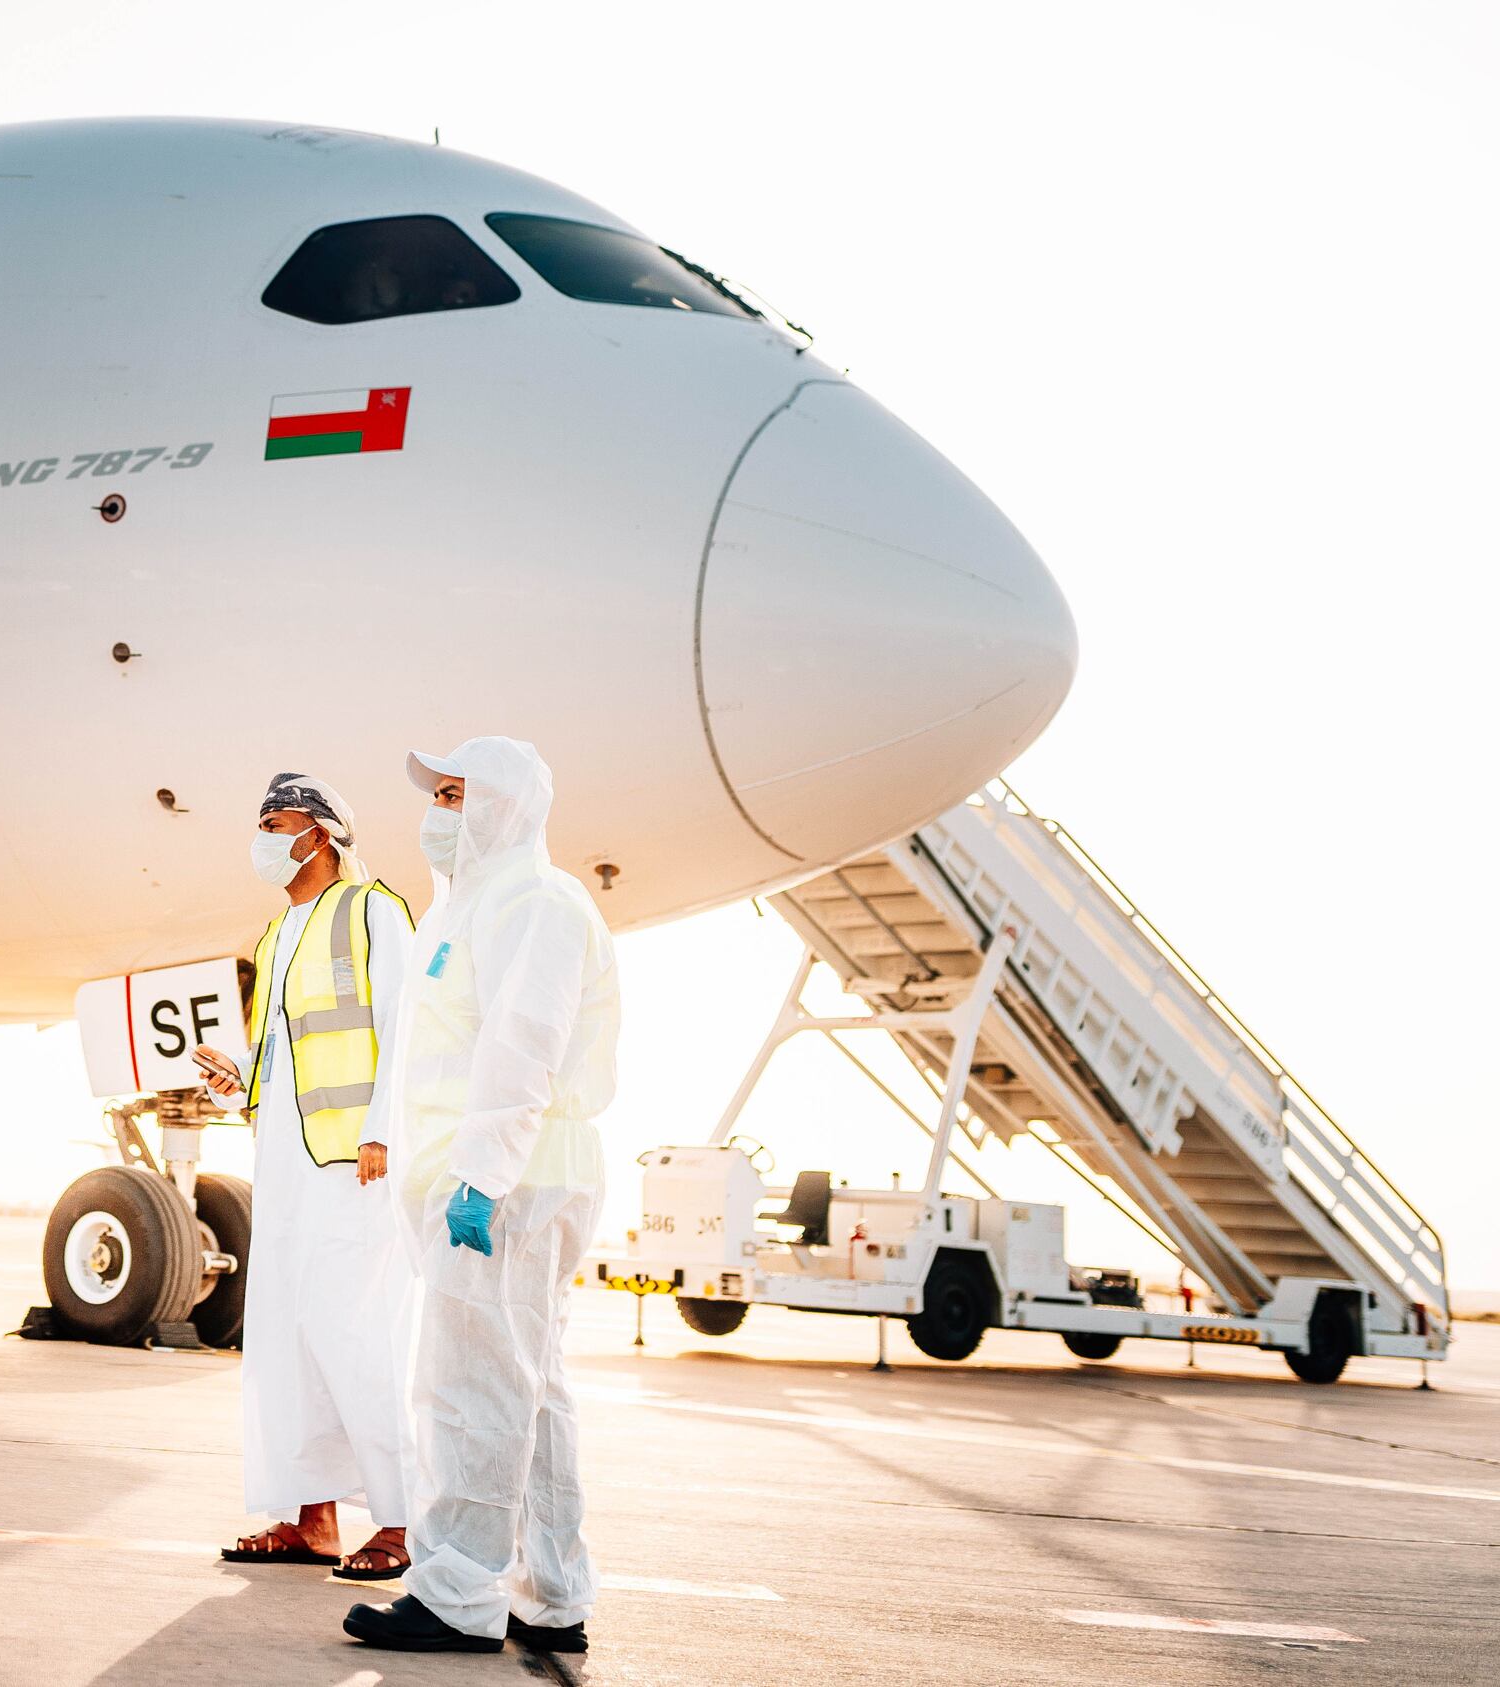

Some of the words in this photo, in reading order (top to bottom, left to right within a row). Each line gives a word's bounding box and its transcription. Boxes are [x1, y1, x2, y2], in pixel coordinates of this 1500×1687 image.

[65, 442, 215, 481] 787-9
[150, 994, 219, 1059] SF
[643, 1214, 676, 1233] 586
